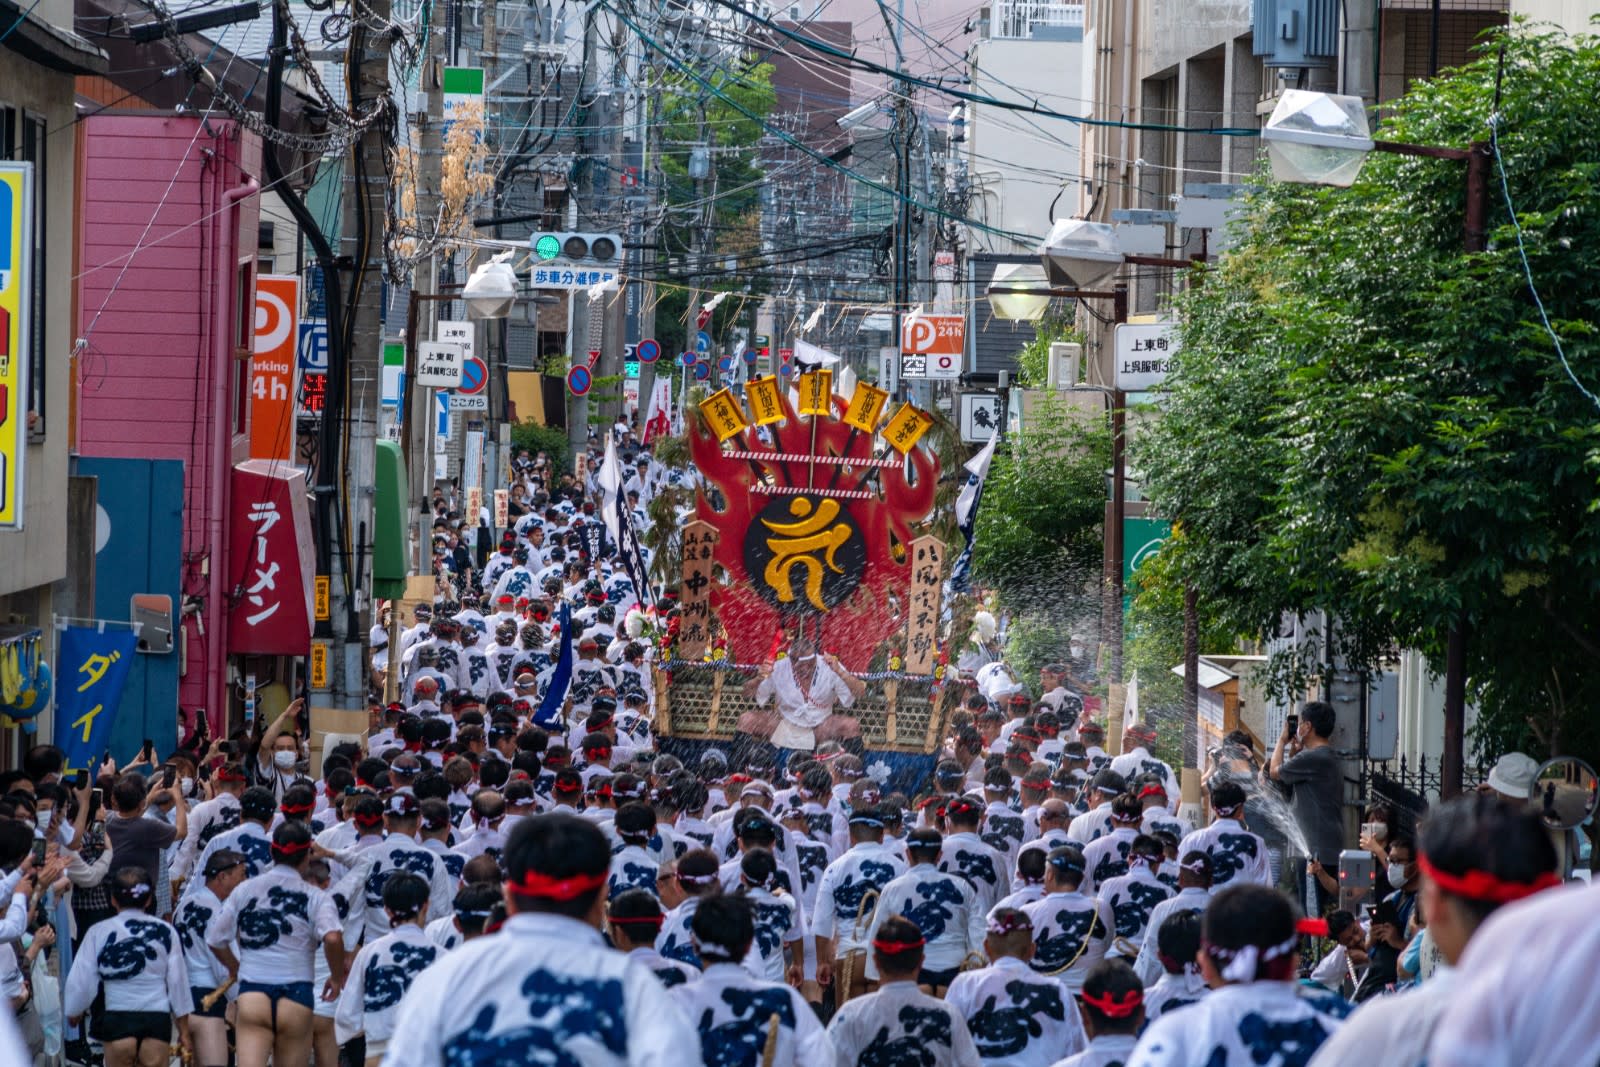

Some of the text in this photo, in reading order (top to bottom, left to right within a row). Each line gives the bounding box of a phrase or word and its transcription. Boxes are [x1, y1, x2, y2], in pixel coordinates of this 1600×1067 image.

[1130, 337, 1169, 352] 上東町
[425, 352, 455, 362] 上東町
[450, 398, 485, 408] ここから
[246, 501, 281, 626] ラーメン
[681, 569, 709, 642] 中洲流
